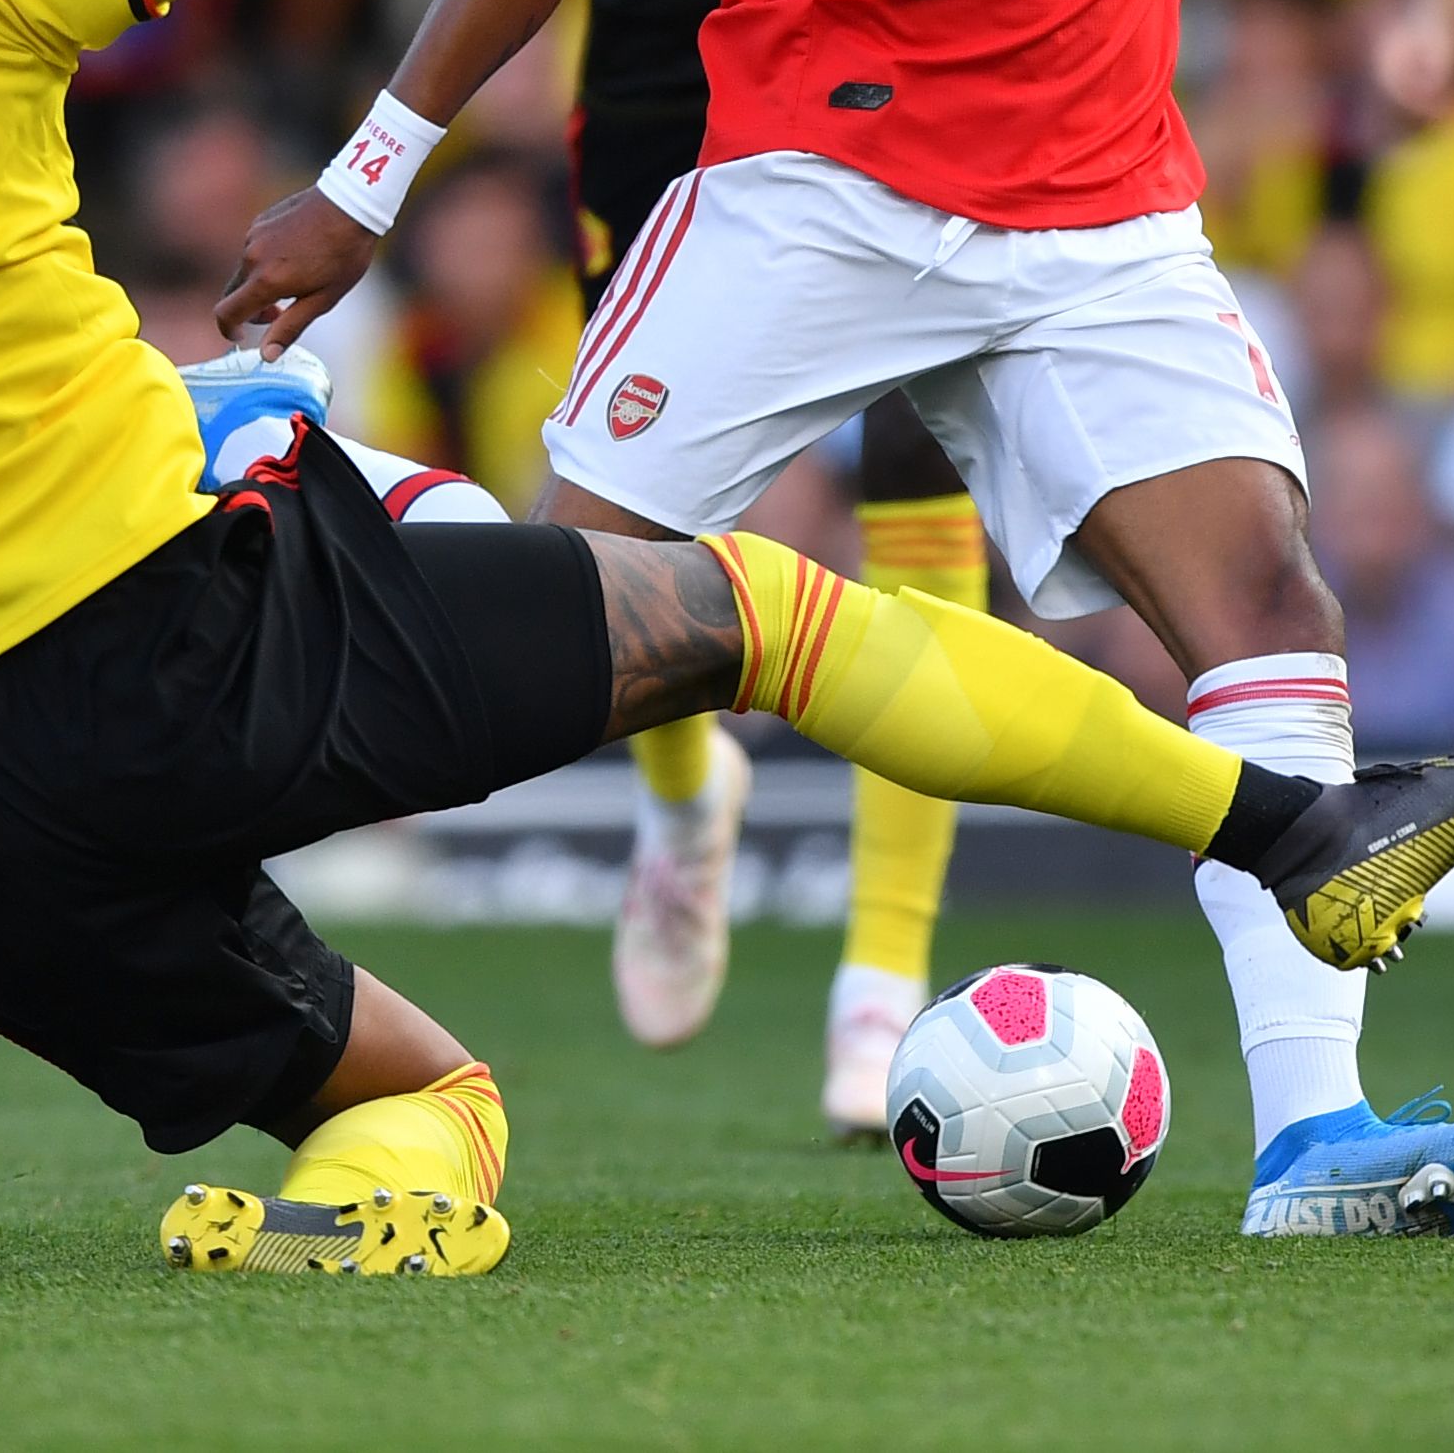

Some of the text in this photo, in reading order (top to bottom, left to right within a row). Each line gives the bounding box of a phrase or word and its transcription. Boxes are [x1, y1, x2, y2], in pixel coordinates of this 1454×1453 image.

[346, 139, 391, 186] 14
[1260, 1193, 1396, 1234] JUST DO
